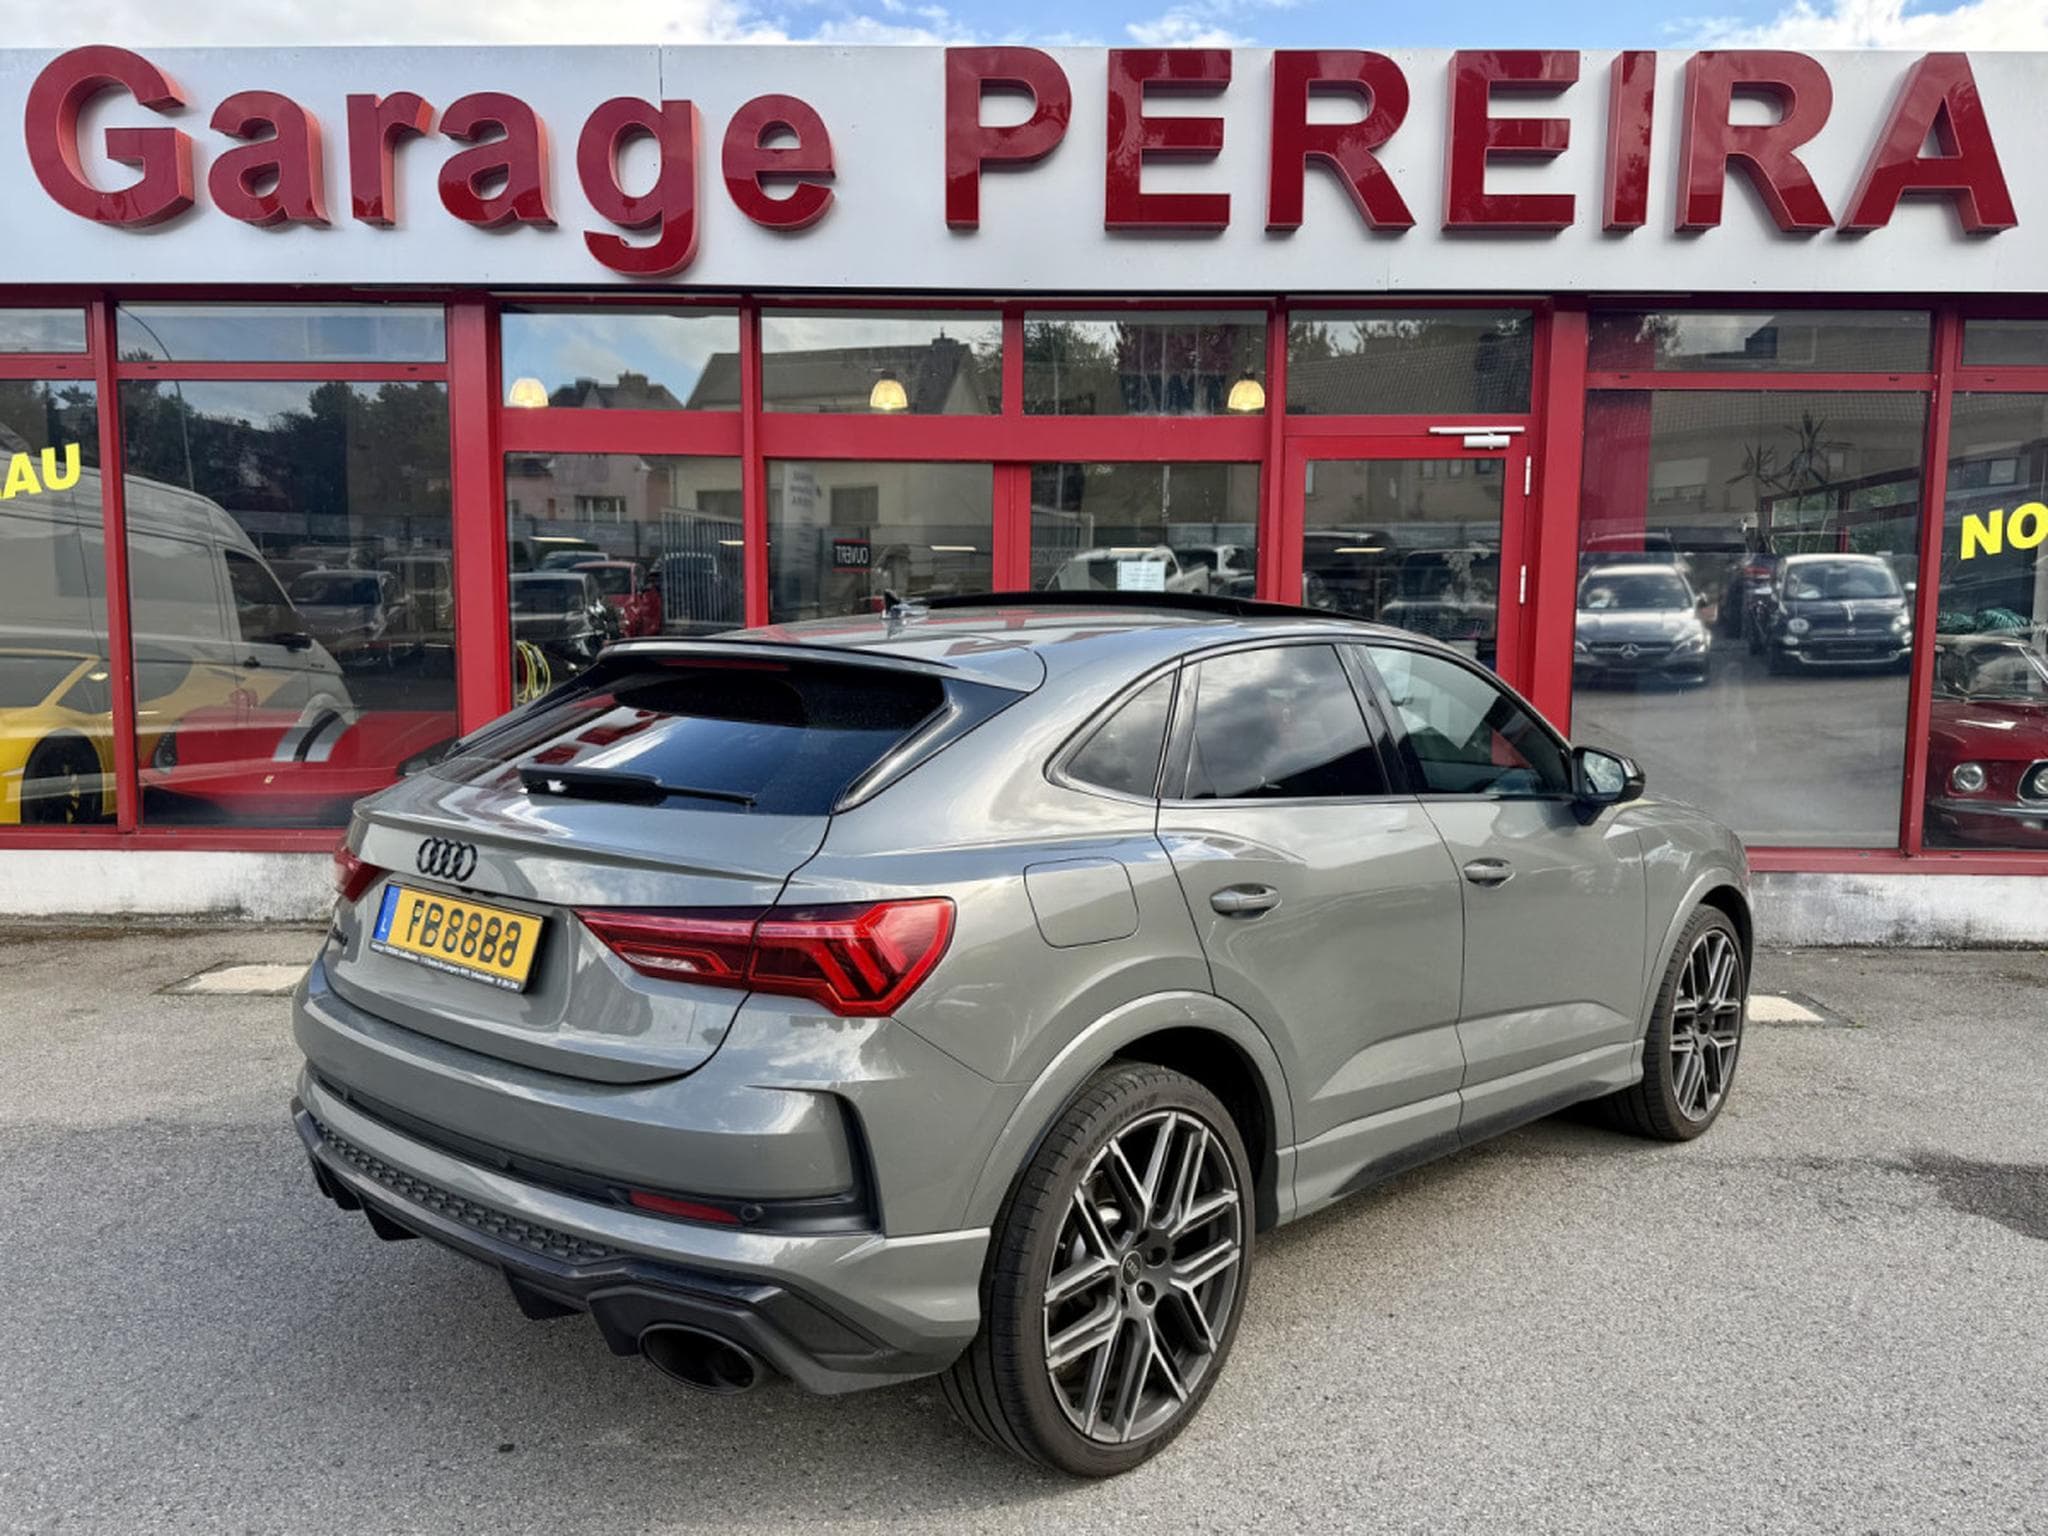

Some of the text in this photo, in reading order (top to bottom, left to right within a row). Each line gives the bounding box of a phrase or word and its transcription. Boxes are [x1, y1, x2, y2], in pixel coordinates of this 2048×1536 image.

[25, 45, 2018, 278] Garage PEREIRA
[0, 442, 81, 500] AU
